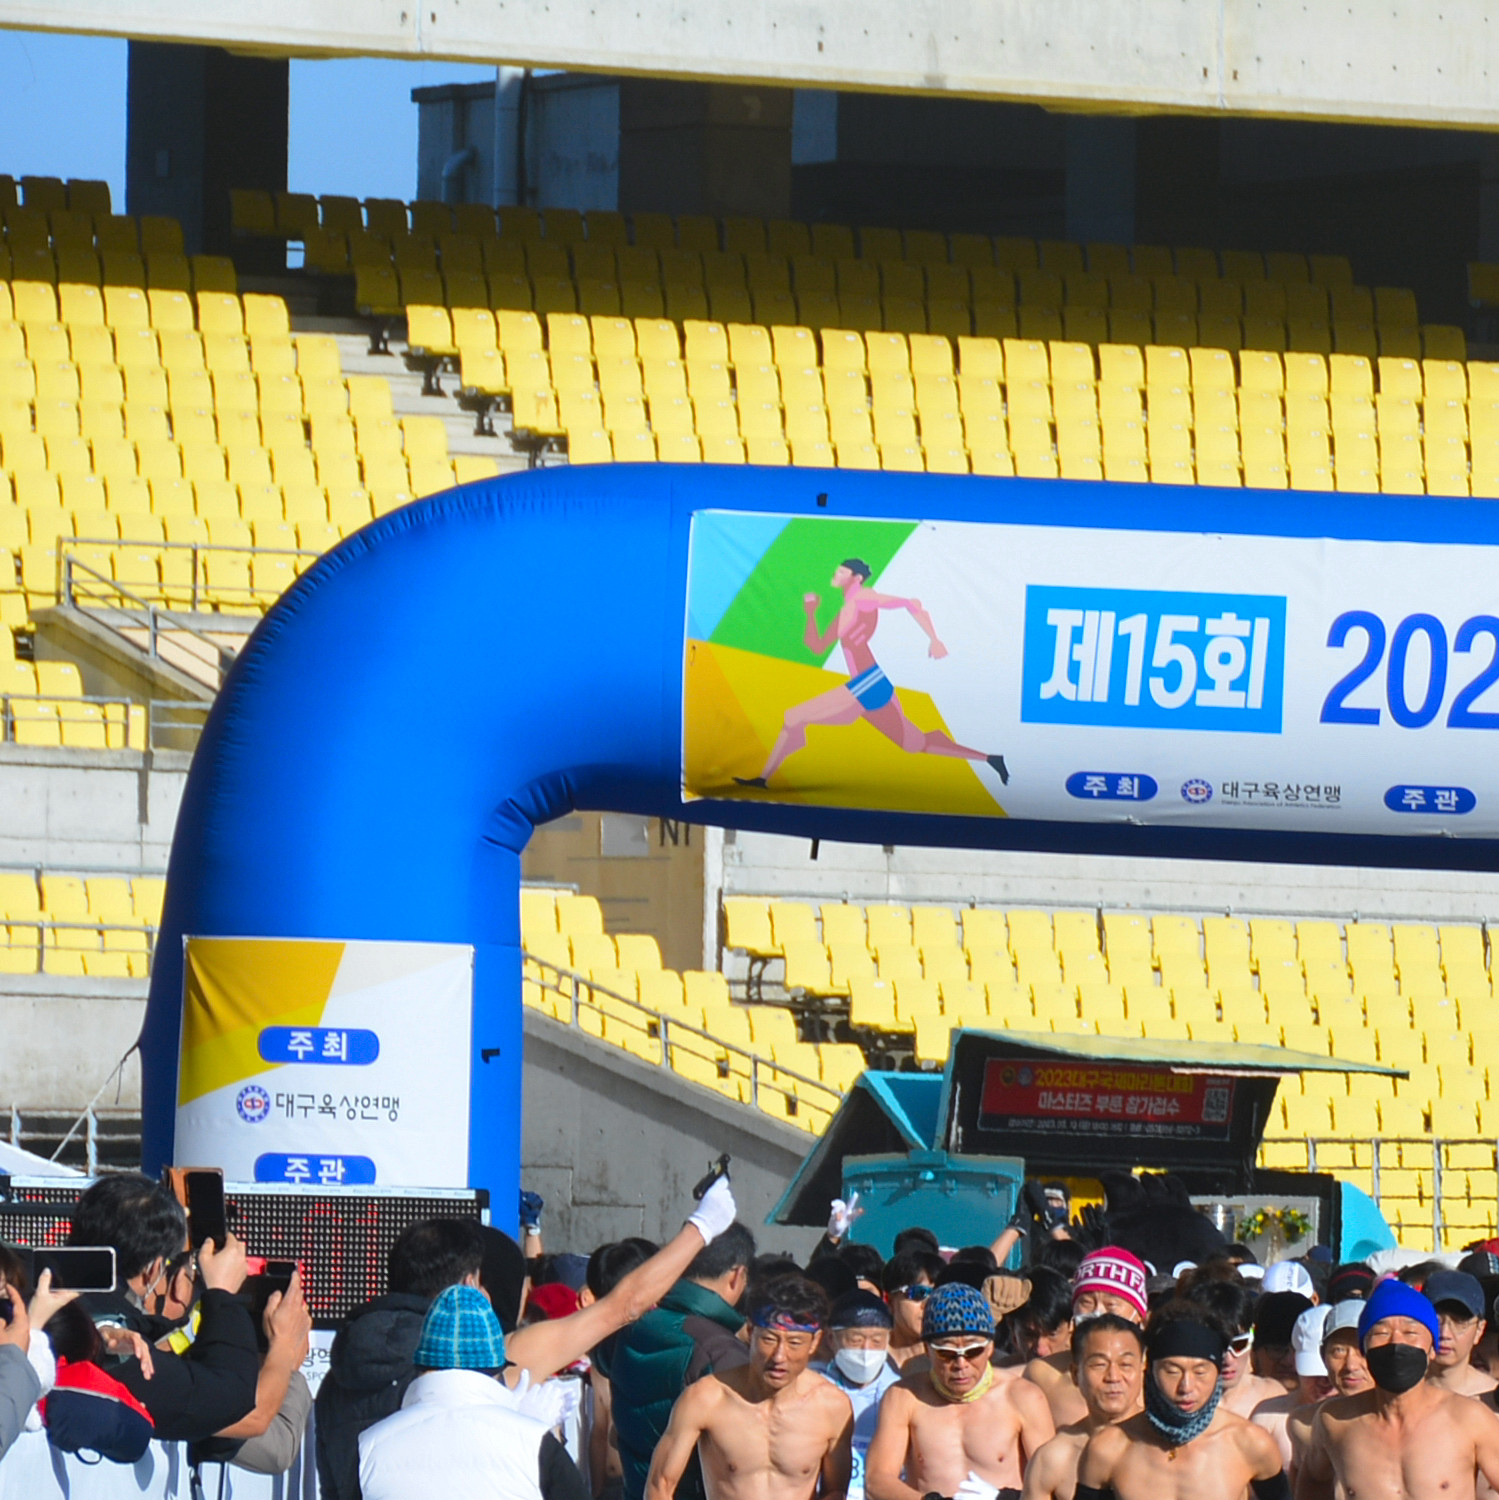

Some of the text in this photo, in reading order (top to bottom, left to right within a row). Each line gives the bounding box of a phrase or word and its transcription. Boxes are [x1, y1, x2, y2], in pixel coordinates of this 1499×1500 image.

[1039, 607, 1271, 710] 제15회
[1221, 780, 1341, 803] 대구육상연맹
[275, 1092, 400, 1122] 대구육상연맹
